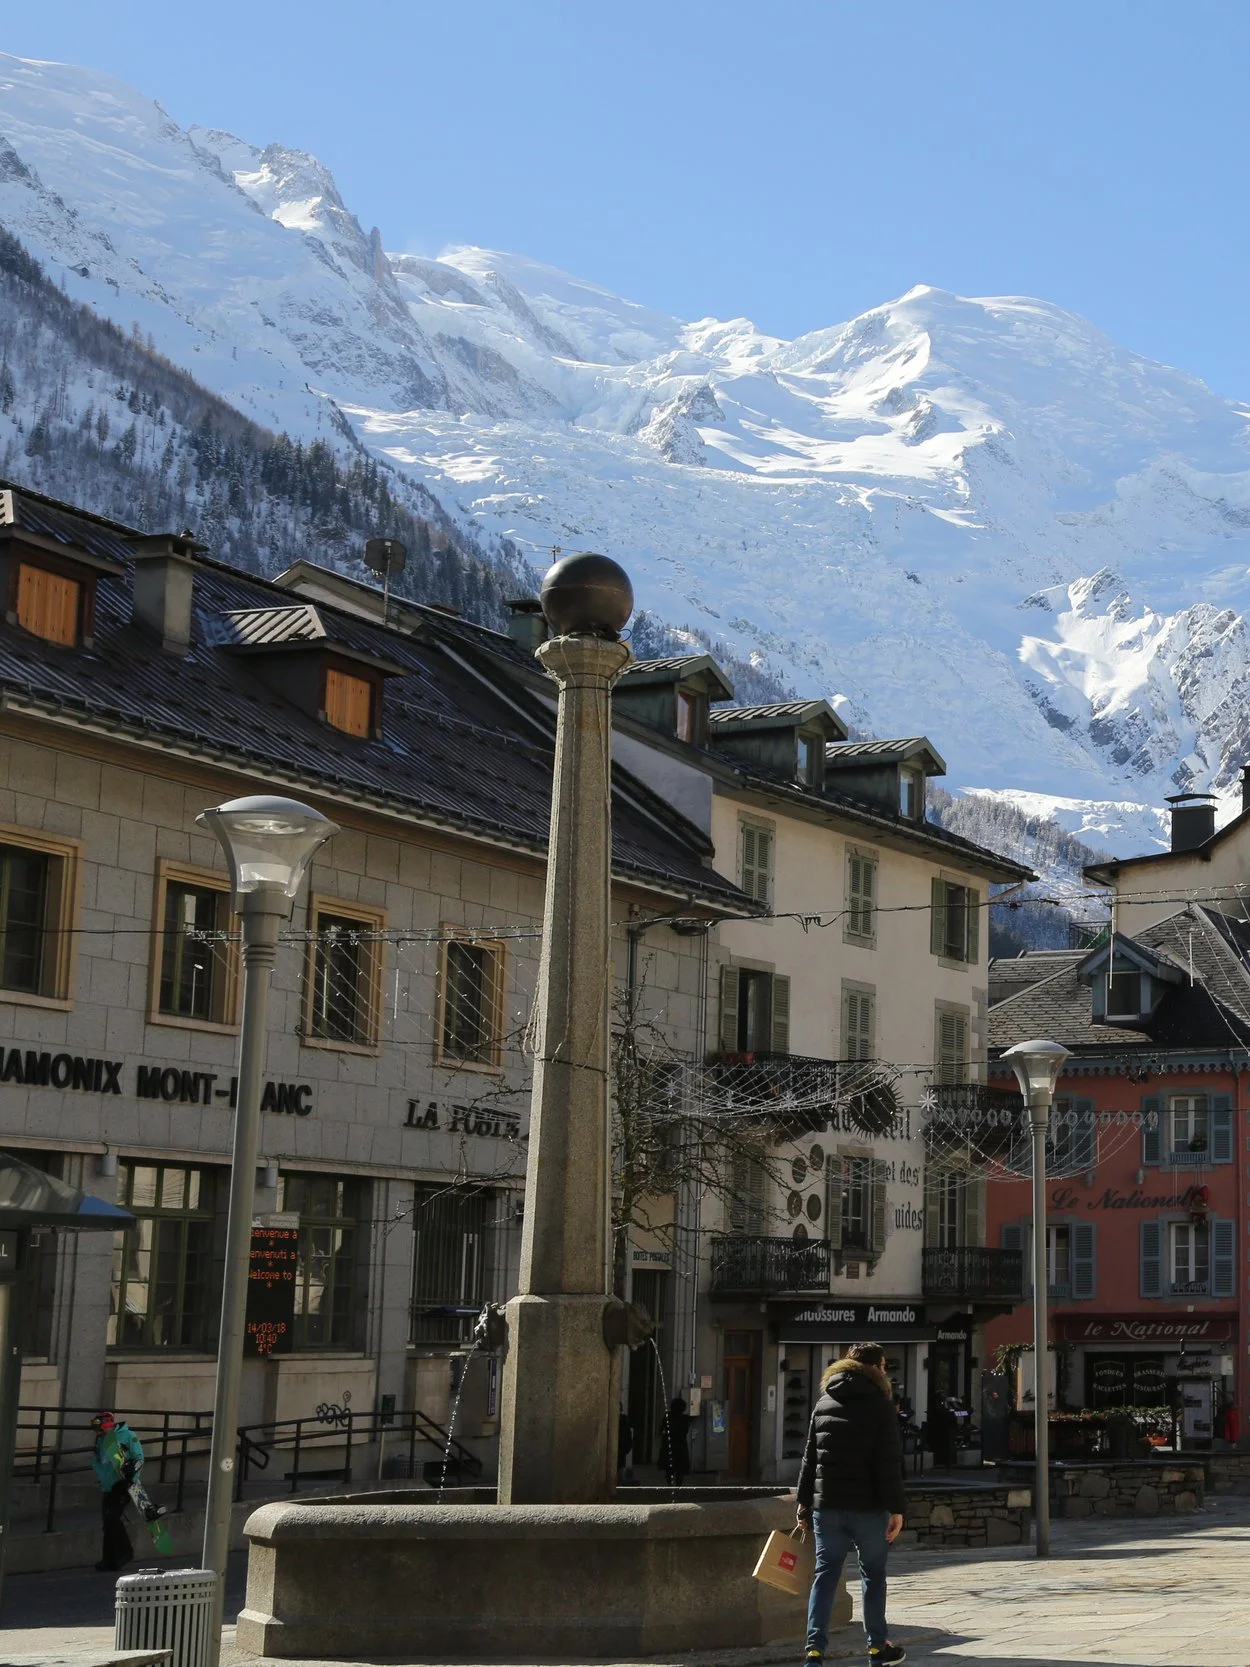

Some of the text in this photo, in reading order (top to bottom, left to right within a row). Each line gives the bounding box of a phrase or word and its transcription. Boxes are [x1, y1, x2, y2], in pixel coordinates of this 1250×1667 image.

[136, 1065, 313, 1116] MONT-ANC
[403, 1098, 441, 1130] LA
[899, 1160, 920, 1186] des
[1051, 1184, 1193, 1210] Le National
[283, 1271, 292, 1280] to
[867, 1306, 916, 1322] Armando
[247, 1323, 286, 1334] 14/03/18
[937, 1329, 967, 1340] Armando
[1084, 1321, 1210, 1340] le National
[255, 1333, 277, 1344] 10:40
